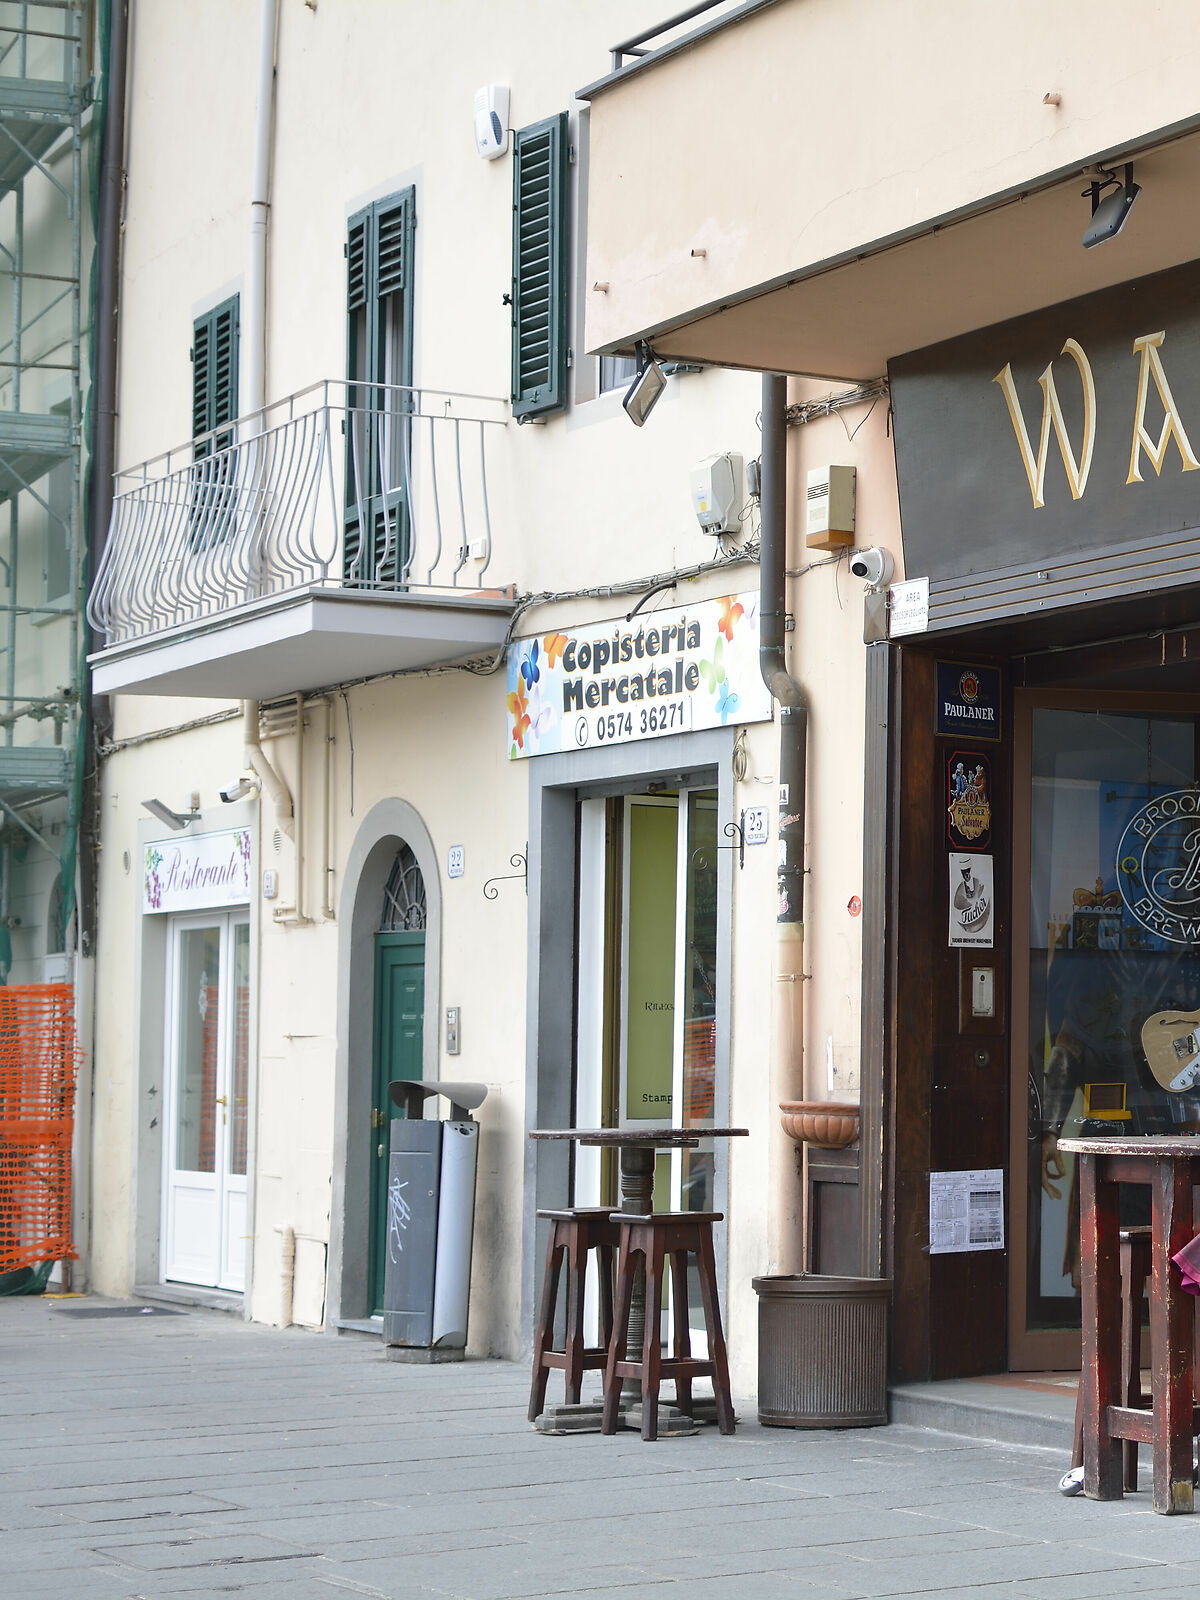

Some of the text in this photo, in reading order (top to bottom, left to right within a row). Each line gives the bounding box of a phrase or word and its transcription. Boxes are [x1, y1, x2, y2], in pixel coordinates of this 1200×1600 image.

[562, 614, 701, 674] Copisteria
[562, 656, 701, 713] Mercatale
[596, 701, 685, 741] 0574 36271
[944, 702, 995, 721] PAULANER
[957, 806, 986, 817] PAULANER
[161, 847, 239, 894] Ristorante
[961, 897, 988, 924] Tucher
